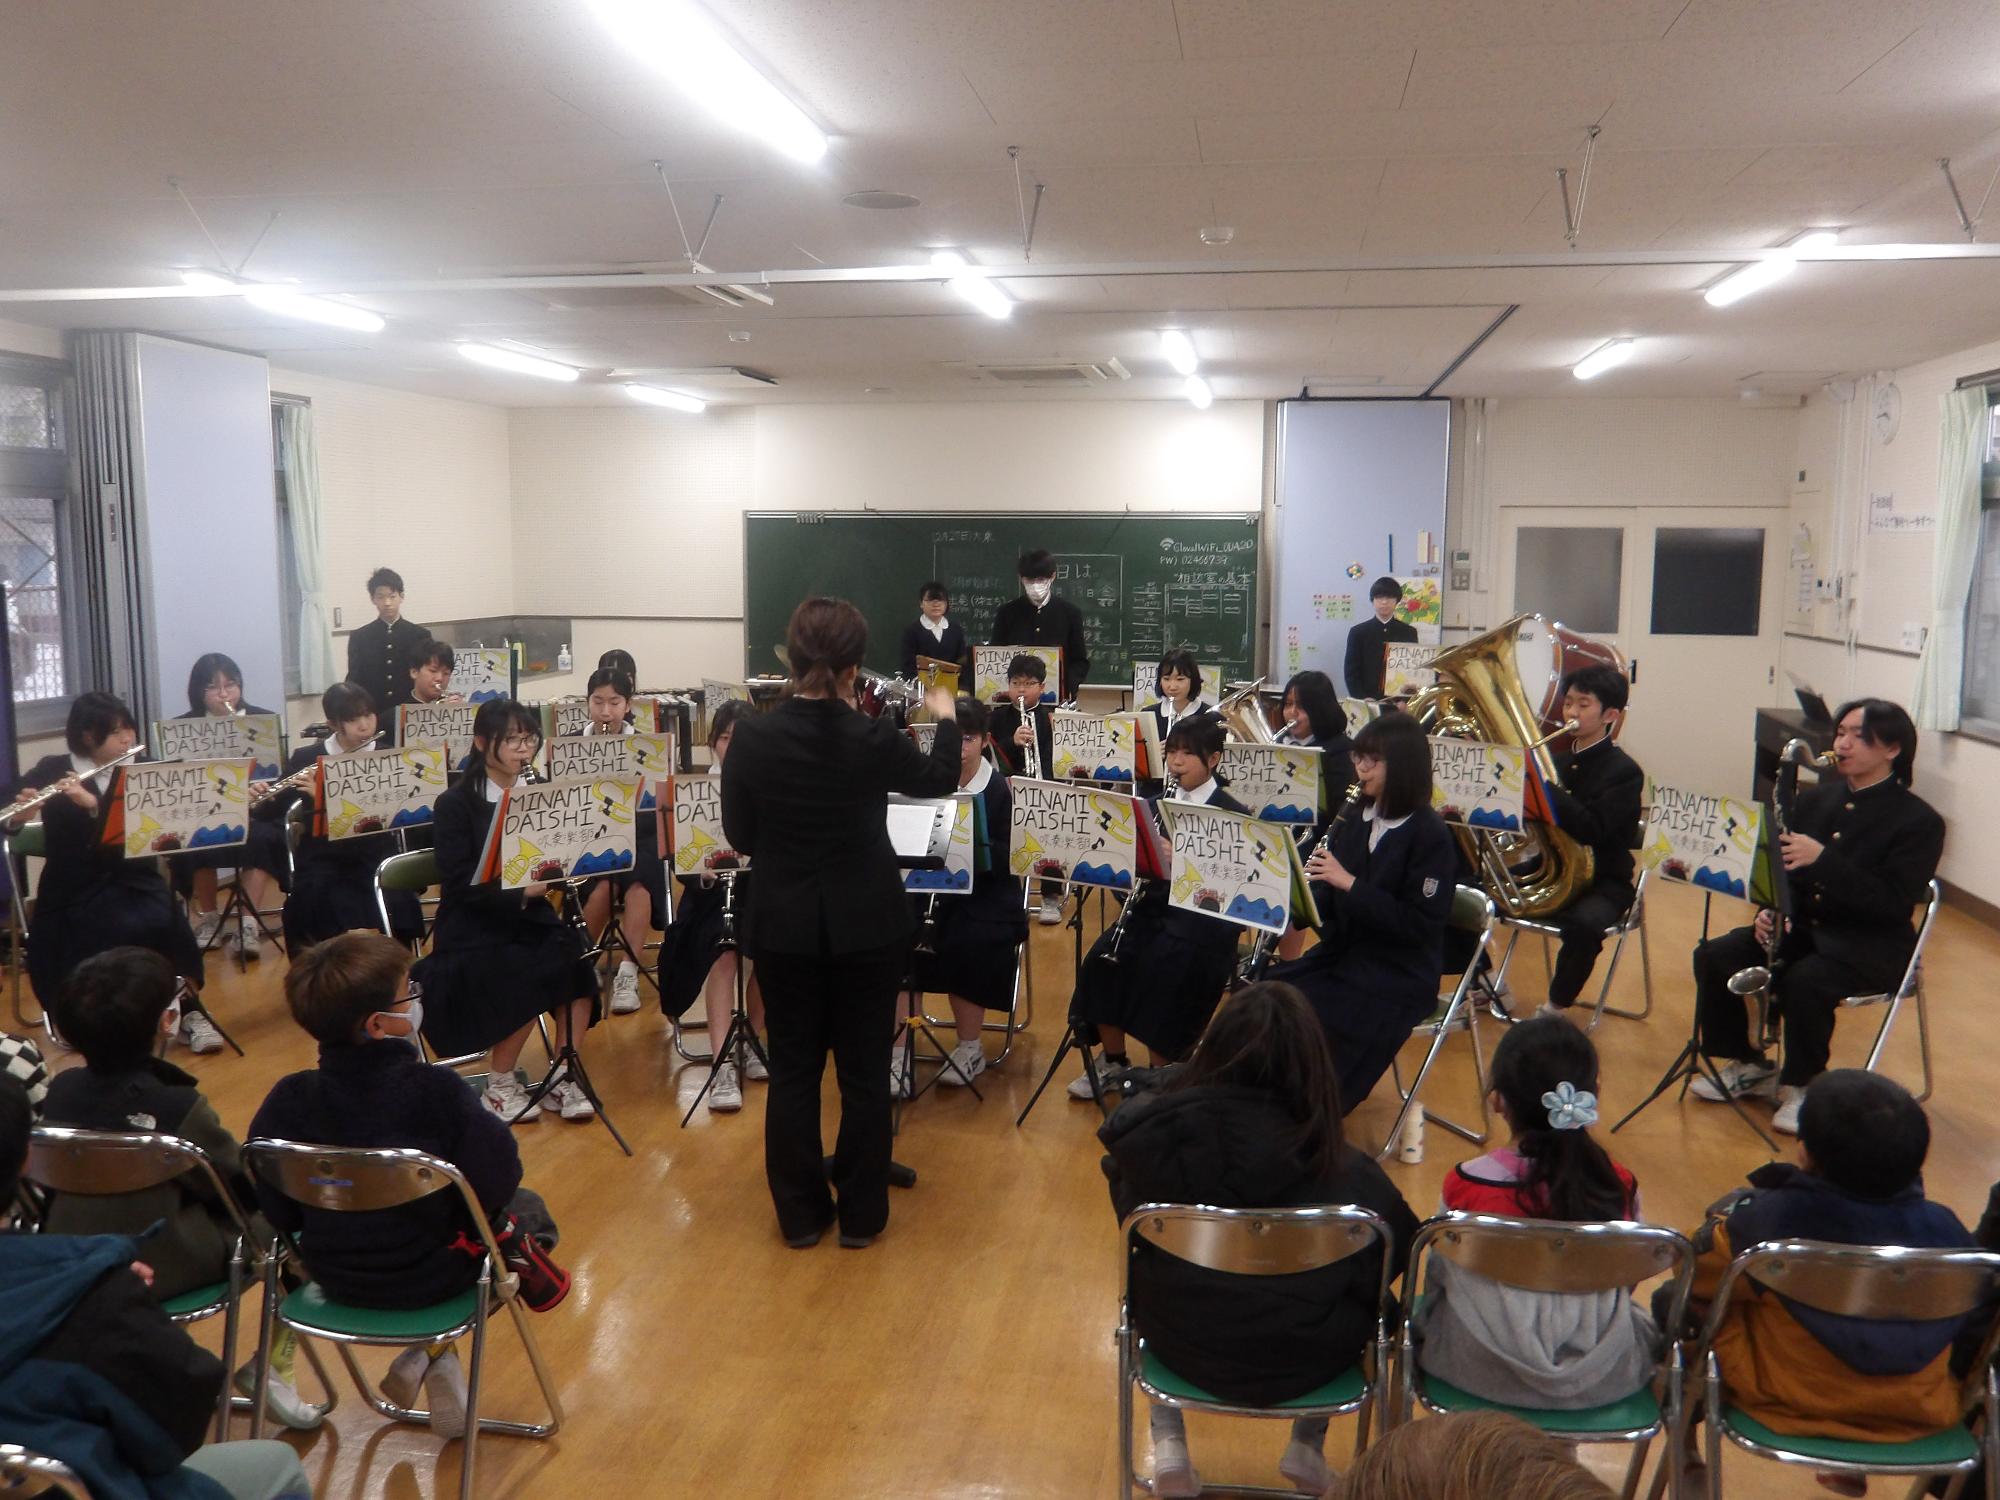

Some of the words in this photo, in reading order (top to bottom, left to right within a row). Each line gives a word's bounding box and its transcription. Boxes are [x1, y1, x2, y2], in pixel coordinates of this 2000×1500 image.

[454, 653, 481, 664] AMI
[1389, 647, 1436, 659] MINAMI
[452, 665, 482, 676] SHI
[976, 663, 1009, 676] DAIS
[406, 708, 473, 723] MINAMI
[555, 708, 591, 722] MIN
[1053, 718, 1105, 733] MINAMI
[162, 720, 240, 740] MINAMI
[406, 722, 476, 737] DAISHI
[558, 721, 591, 736] DAI
[165, 736, 240, 755] DAISHI
[552, 739, 628, 760] MINAMI
[1054, 733, 1107, 747] DAISHI
[325, 753, 405, 780] MINAMI
[552, 757, 629, 777] DAISHI
[1220, 748, 1276, 766] INAMI
[126, 767, 208, 792] MINAMI
[1218, 764, 1278, 783] AISHI
[1431, 762, 1486, 783] AISHI
[327, 771, 407, 798] DAISHI
[675, 780, 721, 802] MIN
[127, 787, 208, 811] DAISHI
[506, 785, 593, 815] MINAMI
[1012, 786, 1090, 815] MINAMI
[1652, 785, 1719, 819] MINAMI
[505, 807, 595, 835] DAISHI
[677, 801, 719, 823] DAI
[1013, 808, 1091, 835] DAISHI
[1650, 805, 1716, 839] DAISHI
[1171, 812, 1246, 844] MINAMI
[1174, 832, 1247, 866] DAISHI
